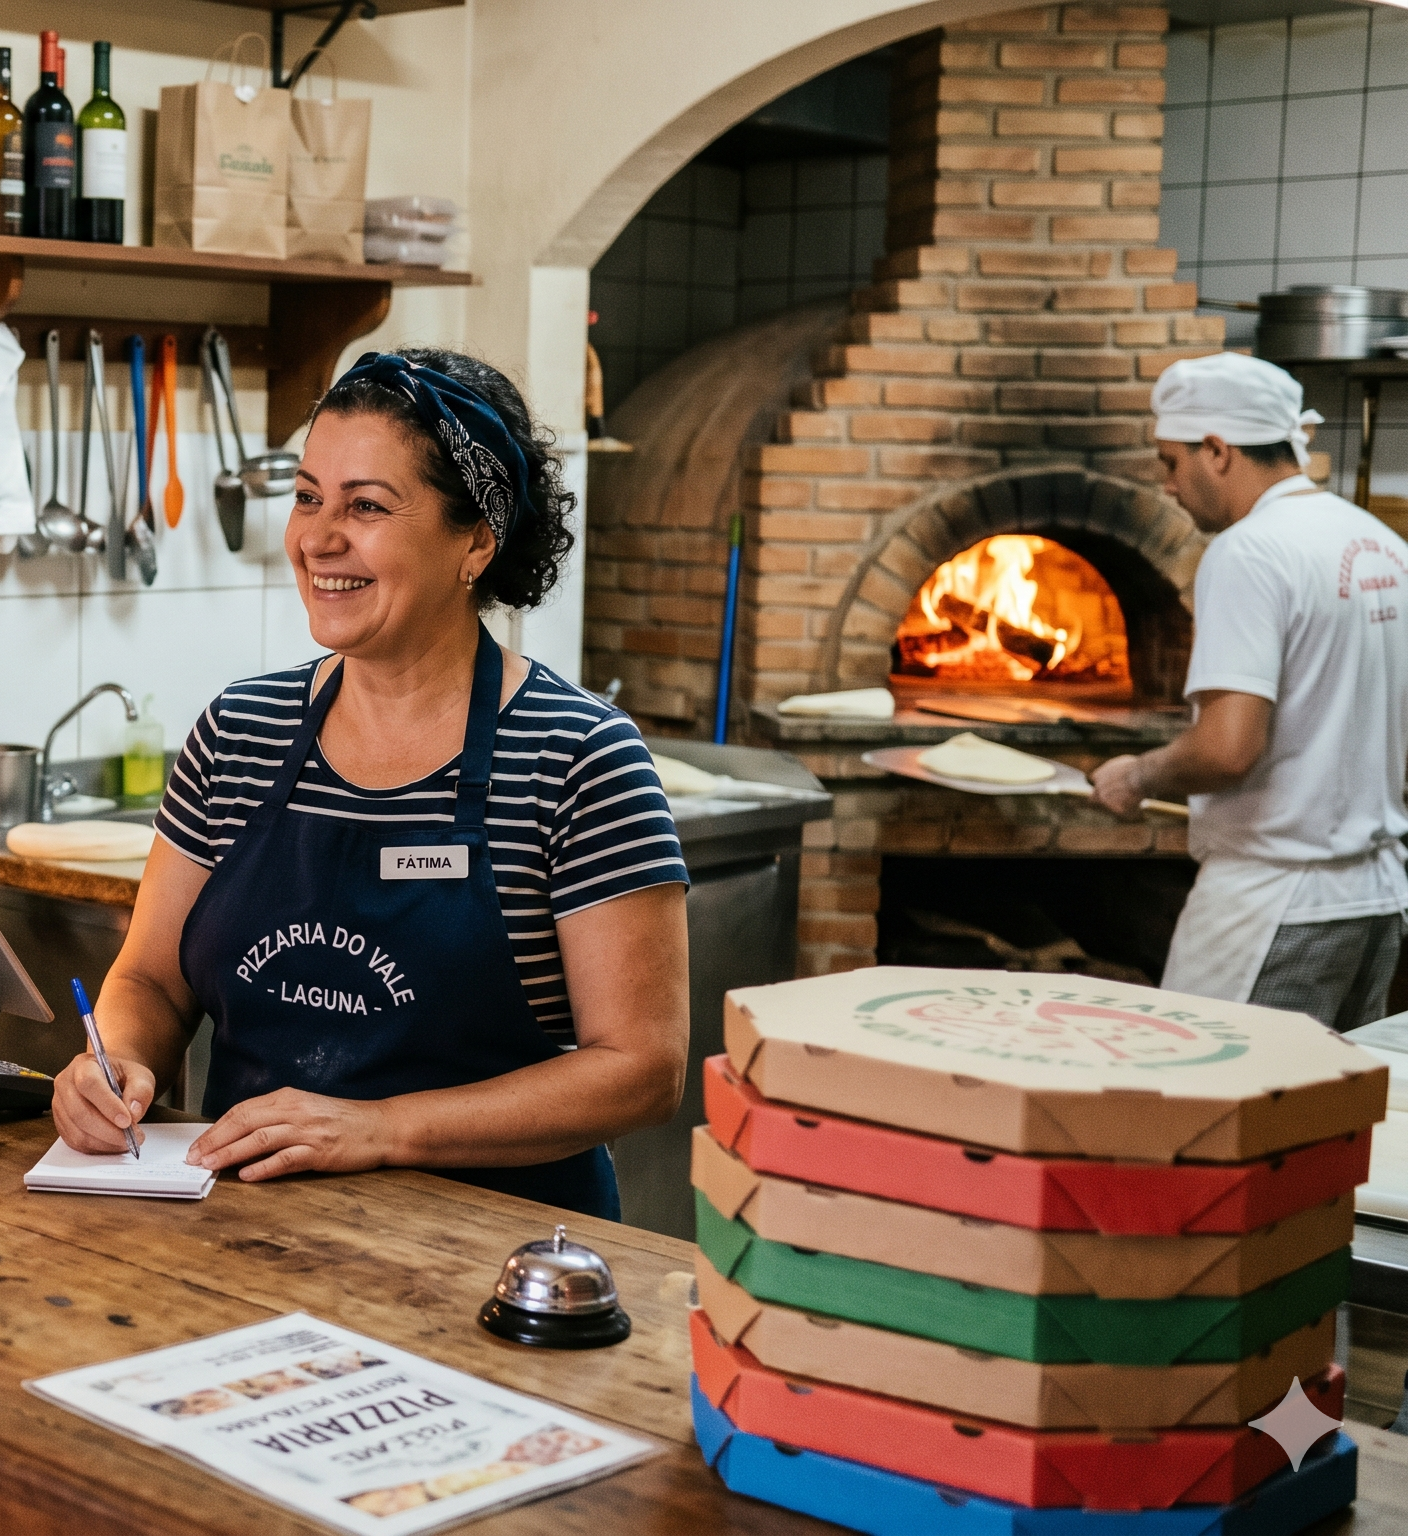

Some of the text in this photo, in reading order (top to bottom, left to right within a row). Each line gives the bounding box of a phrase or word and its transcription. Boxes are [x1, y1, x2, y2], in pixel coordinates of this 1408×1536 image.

[396, 854, 452, 869] FÁTIMA
[236, 922, 415, 1006] PIZZARIA DO VALE
[281, 981, 368, 1015] LAGUNA
